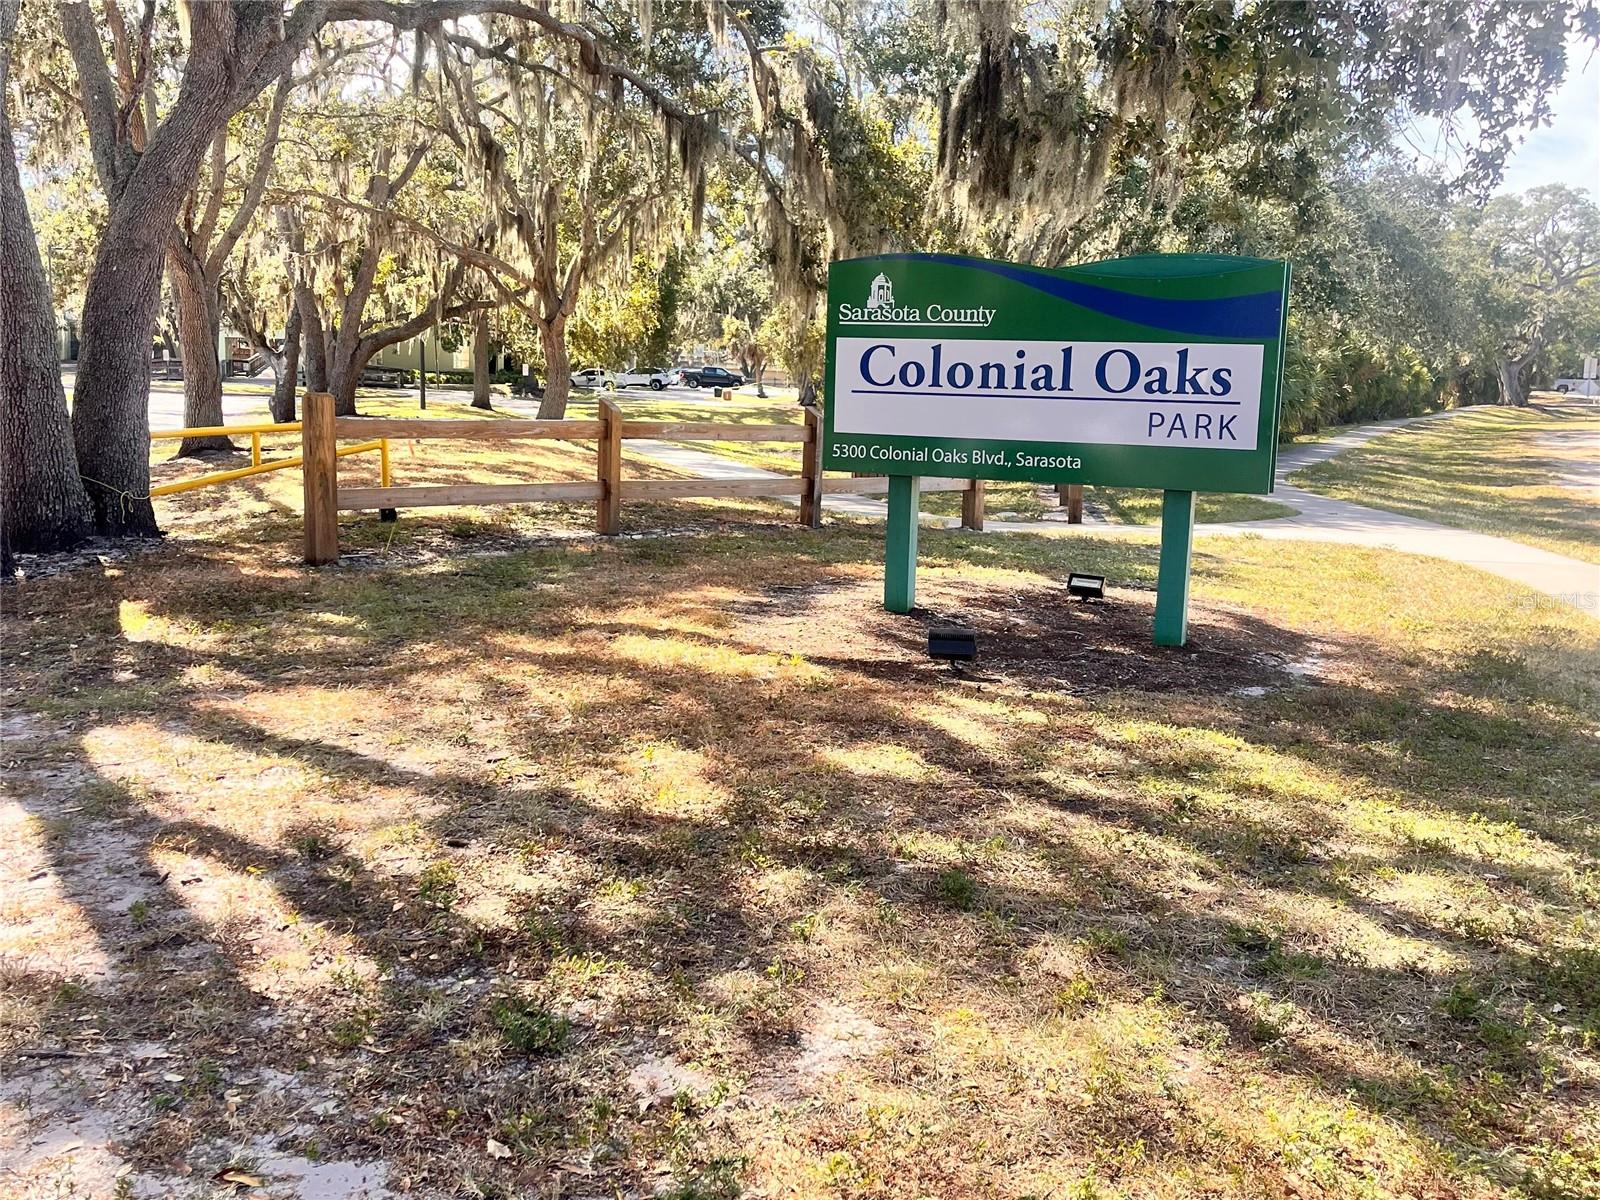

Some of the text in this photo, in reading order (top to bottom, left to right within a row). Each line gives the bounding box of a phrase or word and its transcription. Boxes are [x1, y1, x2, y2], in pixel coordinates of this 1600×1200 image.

[839, 303, 996, 327] Sarasota County
[859, 344, 1232, 397] Colonial Oaks
[1148, 412, 1238, 441] PARK
[832, 444, 1082, 469] 5300 Colonial Oaks Blvd., Sarasota
